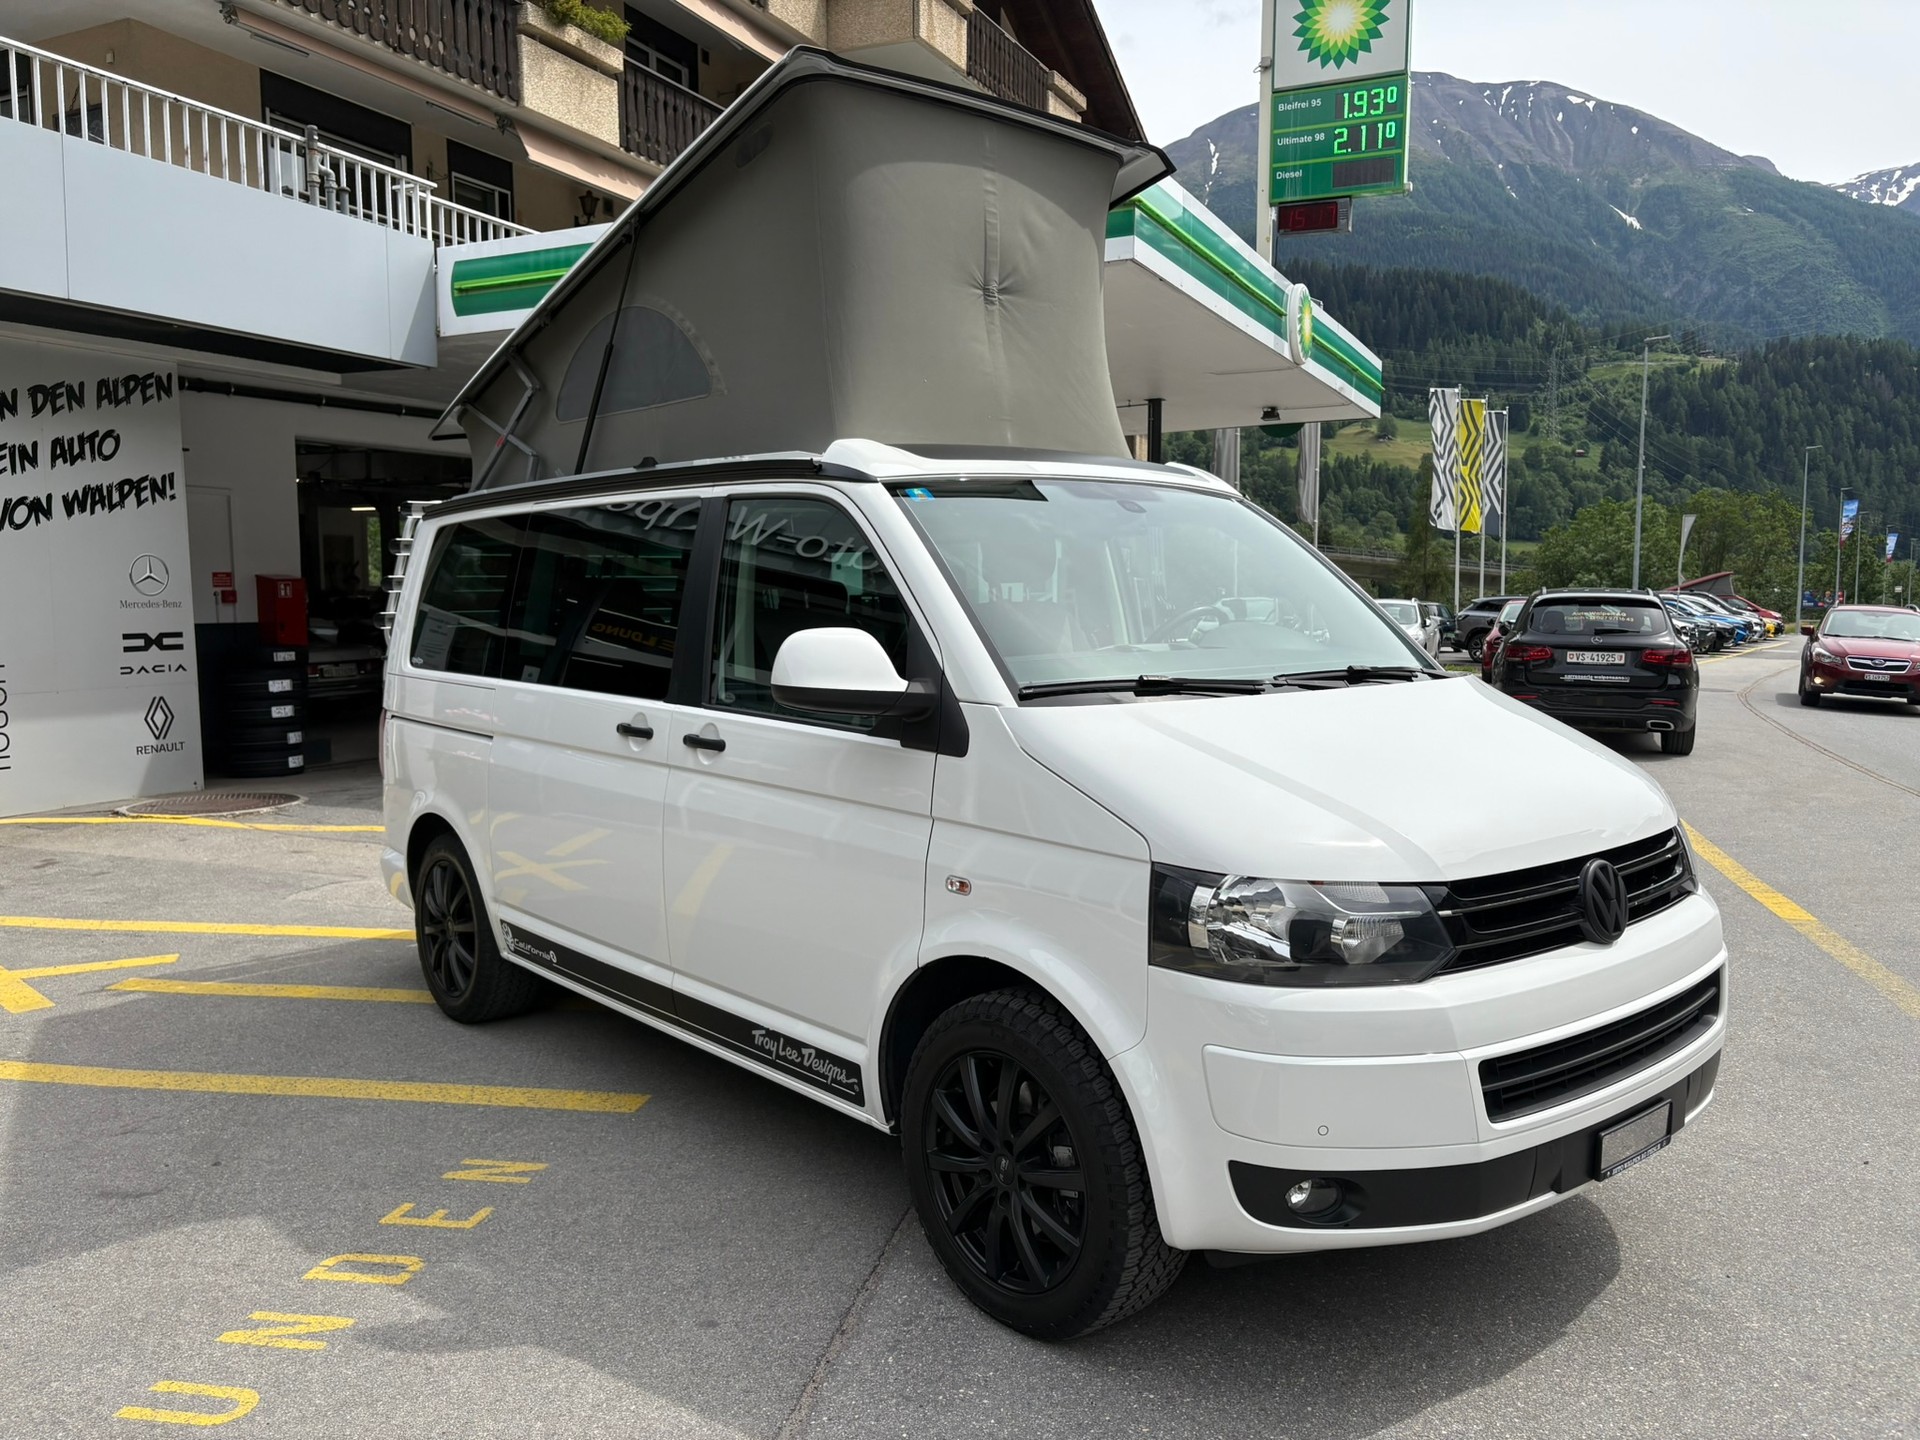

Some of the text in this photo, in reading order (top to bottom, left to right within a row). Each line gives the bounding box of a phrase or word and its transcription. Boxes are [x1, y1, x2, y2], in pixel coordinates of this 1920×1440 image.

[1278, 101, 1309, 112] Bleifrei
[1311, 99, 1322, 108] 95
[1277, 134, 1313, 146] Ultimate
[1314, 133, 1325, 142] 98
[1276, 169, 1303, 180] Diesel
[27, 380, 85, 418] DEN
[96, 372, 173, 410] ALPEN
[51, 429, 121, 470] AUTO
[62, 472, 176, 520] WALPEN!
[119, 600, 183, 609] Mercedes-Benz
[120, 663, 187, 675] DACIA
[136, 741, 185, 755] RENAULT
[514, 938, 550, 960] California
[752, 1029, 858, 1085] Troy Lee Designs
